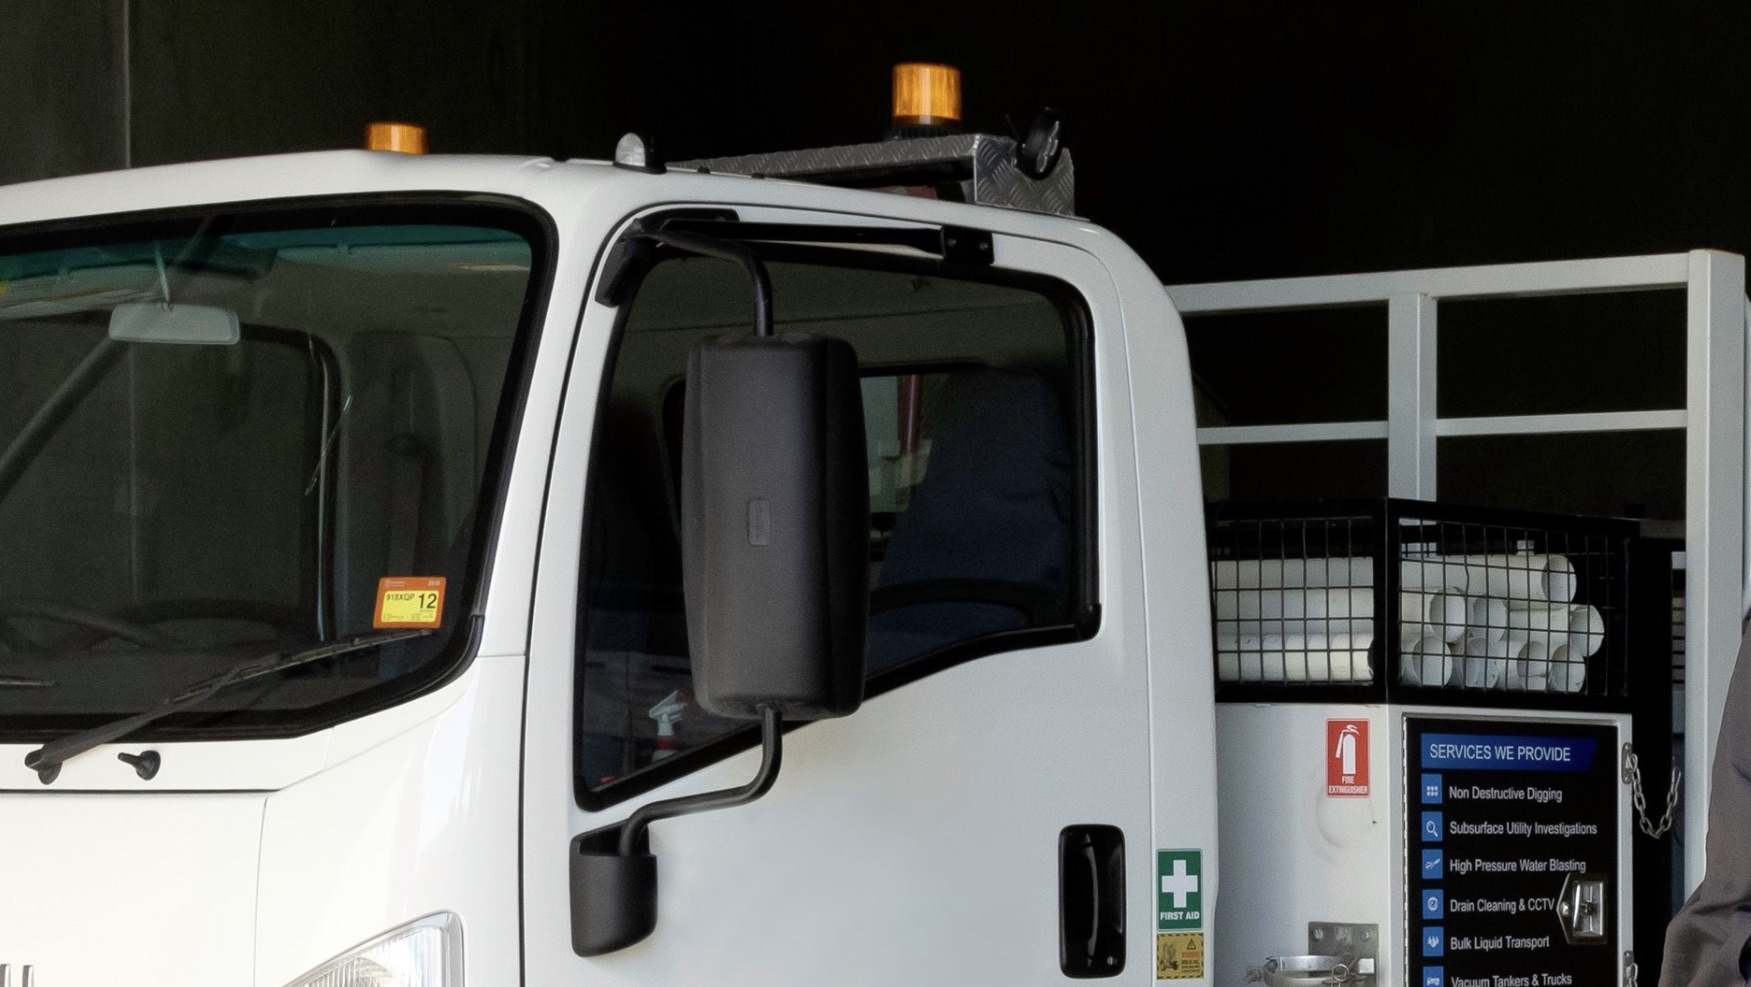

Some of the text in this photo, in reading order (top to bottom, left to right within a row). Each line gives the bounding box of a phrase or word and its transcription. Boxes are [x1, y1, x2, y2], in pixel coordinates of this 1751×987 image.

[418, 592, 437, 609] 12
[1430, 743, 1571, 762] SERVICES WE PROVIDE
[1341, 775, 1355, 784] FIRE
[1449, 786, 1563, 803] Non Destructive Digging
[1450, 821, 1598, 838] Subsurface Utility Investigations
[1450, 859, 1586, 875] High Pressure Water Blasting
[1450, 898, 1555, 915] Drain Cleaning & CCTV
[1160, 910, 1200, 921] FIRST AID
[1450, 935, 1550, 952] Bulk Liquid Transport
[1492, 974, 1530, 987] Tankers
[1531, 974, 1539, 987] &
[1541, 973, 1573, 986] Trucks
